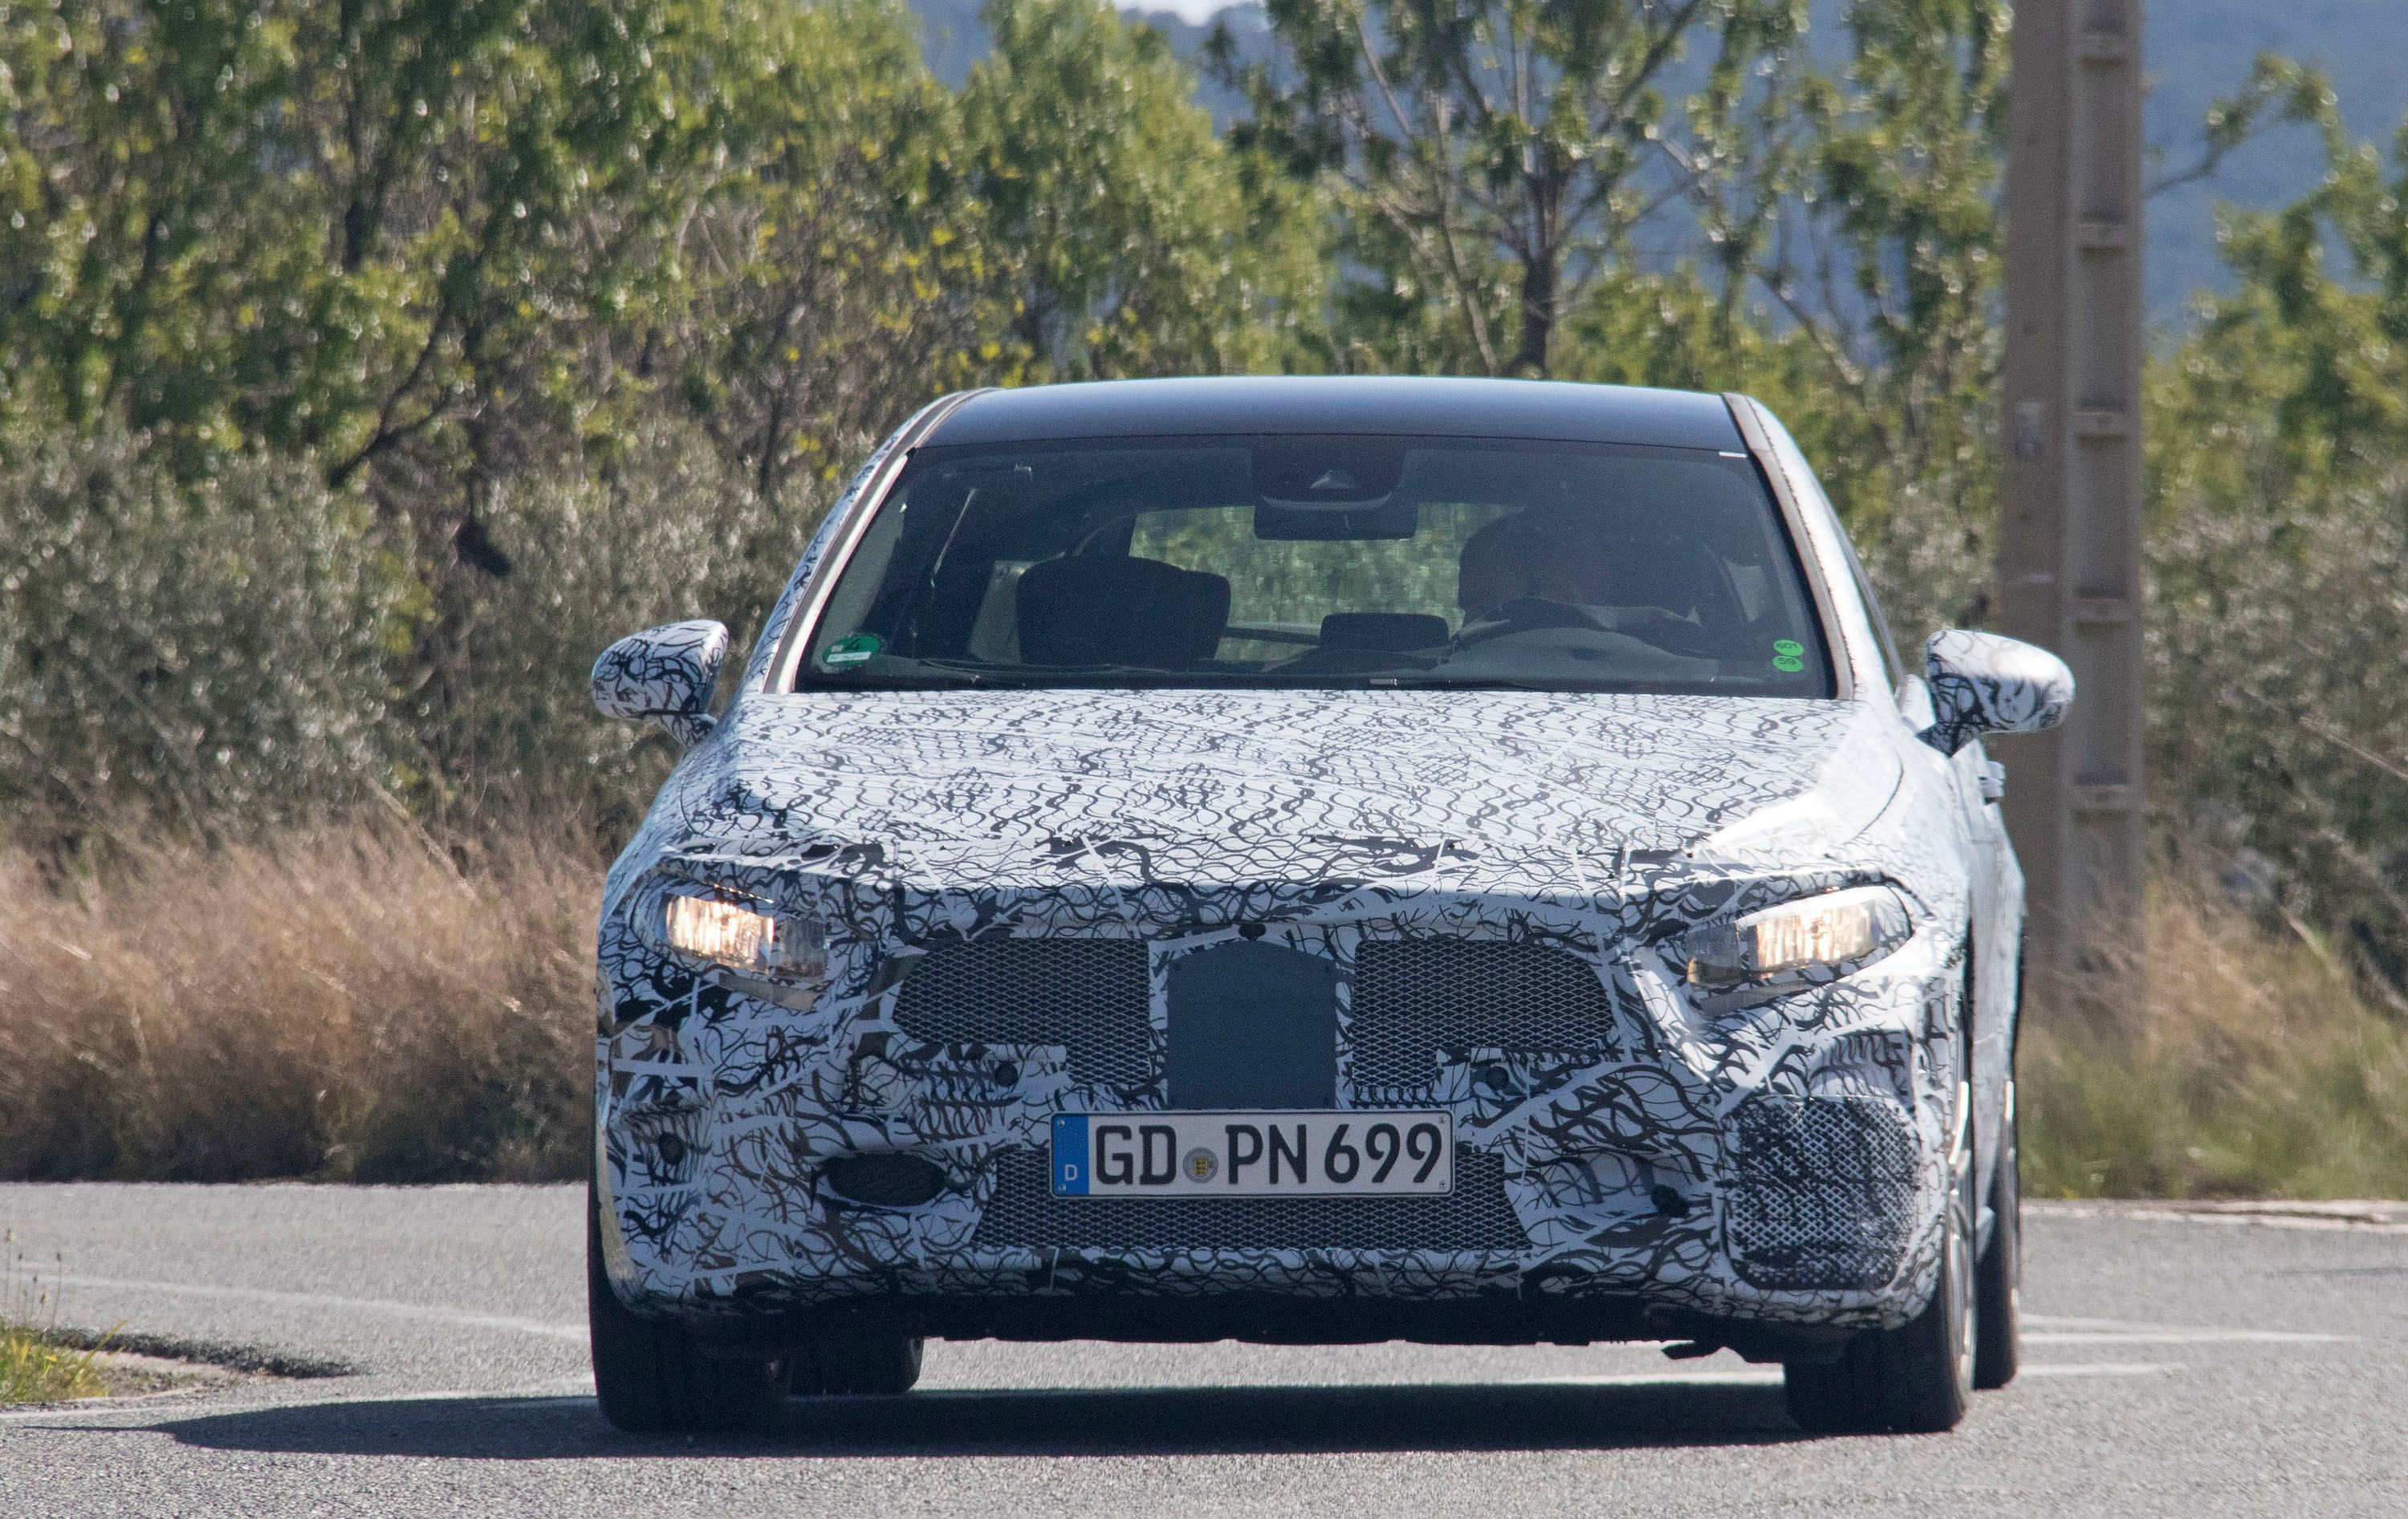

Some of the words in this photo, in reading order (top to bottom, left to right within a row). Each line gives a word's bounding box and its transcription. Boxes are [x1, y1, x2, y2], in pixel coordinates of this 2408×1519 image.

[1064, 1164, 1078, 1181] D
[1096, 1125, 1177, 1185] GD
[1225, 1124, 1308, 1185] PN
[1324, 1123, 1442, 1184] 699
